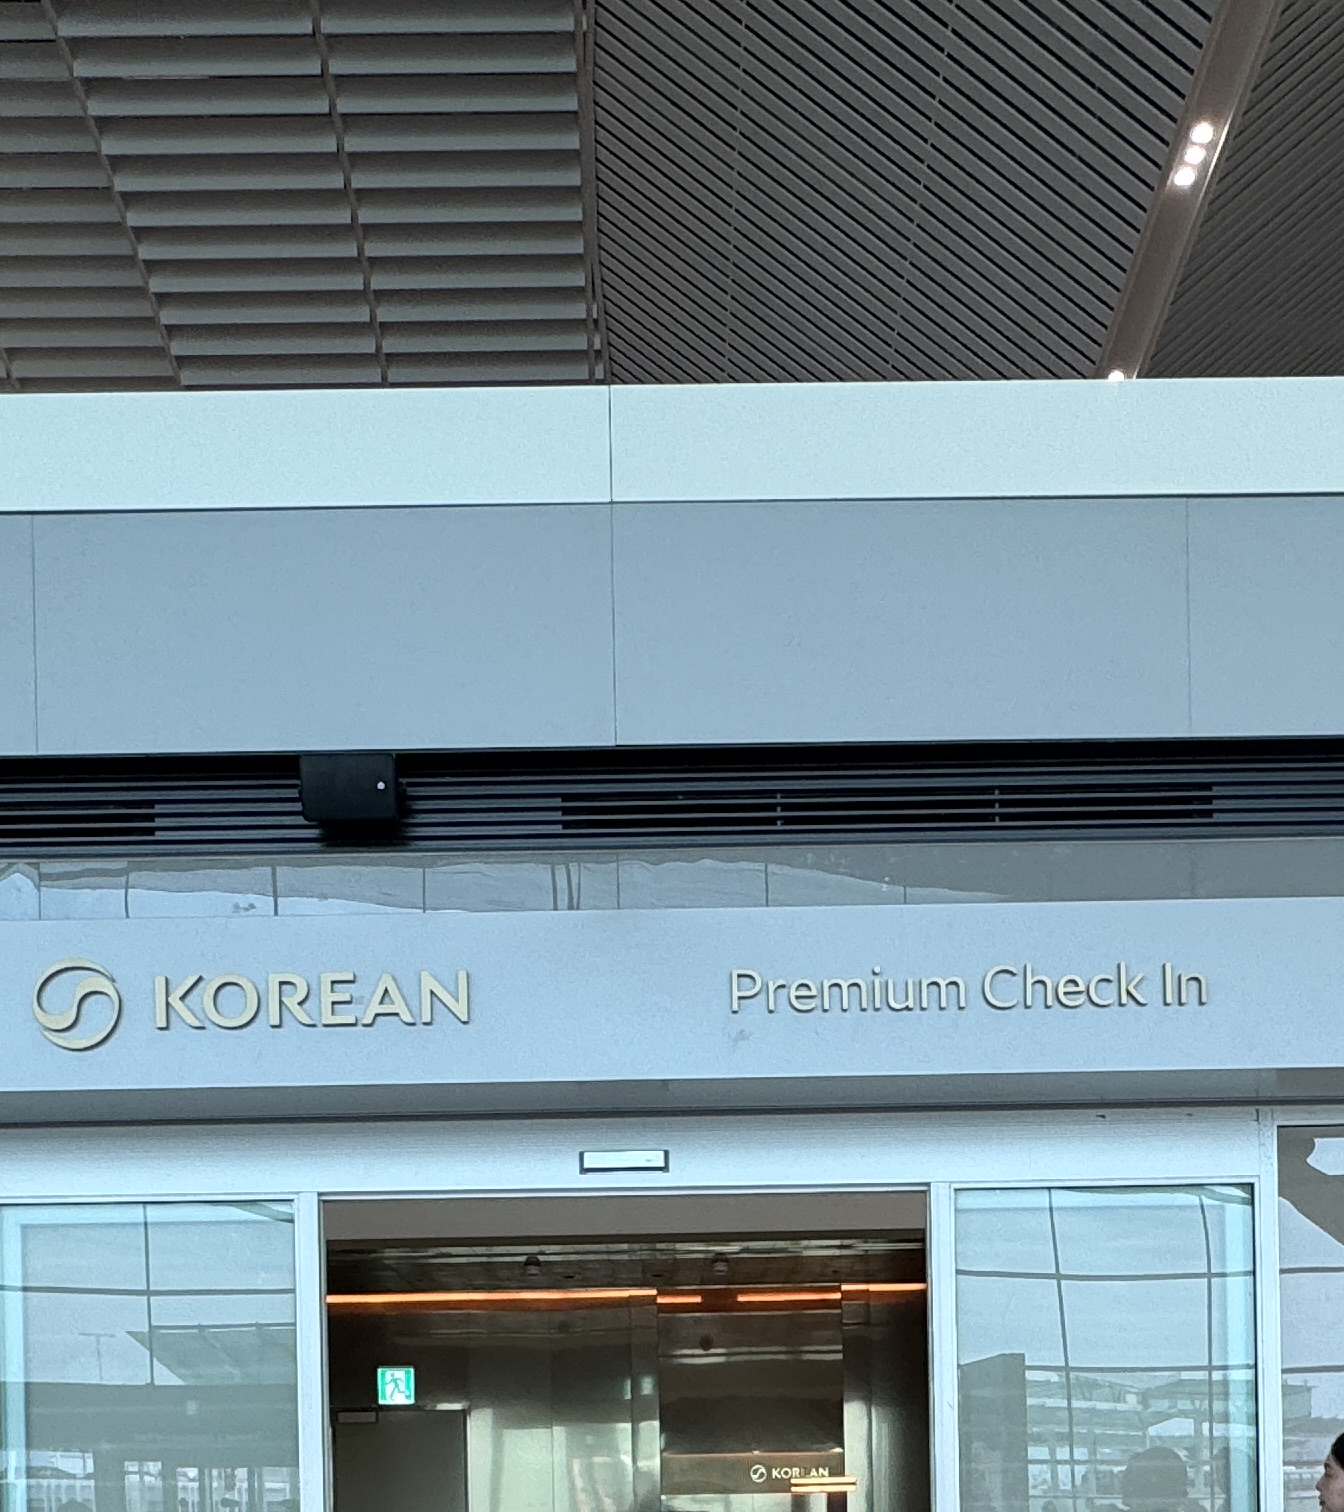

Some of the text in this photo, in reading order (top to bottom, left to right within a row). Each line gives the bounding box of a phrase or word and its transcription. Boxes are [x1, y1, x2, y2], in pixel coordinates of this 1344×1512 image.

[154, 969, 471, 1030] KOREAN
[730, 961, 1209, 1013] Premium Check In
